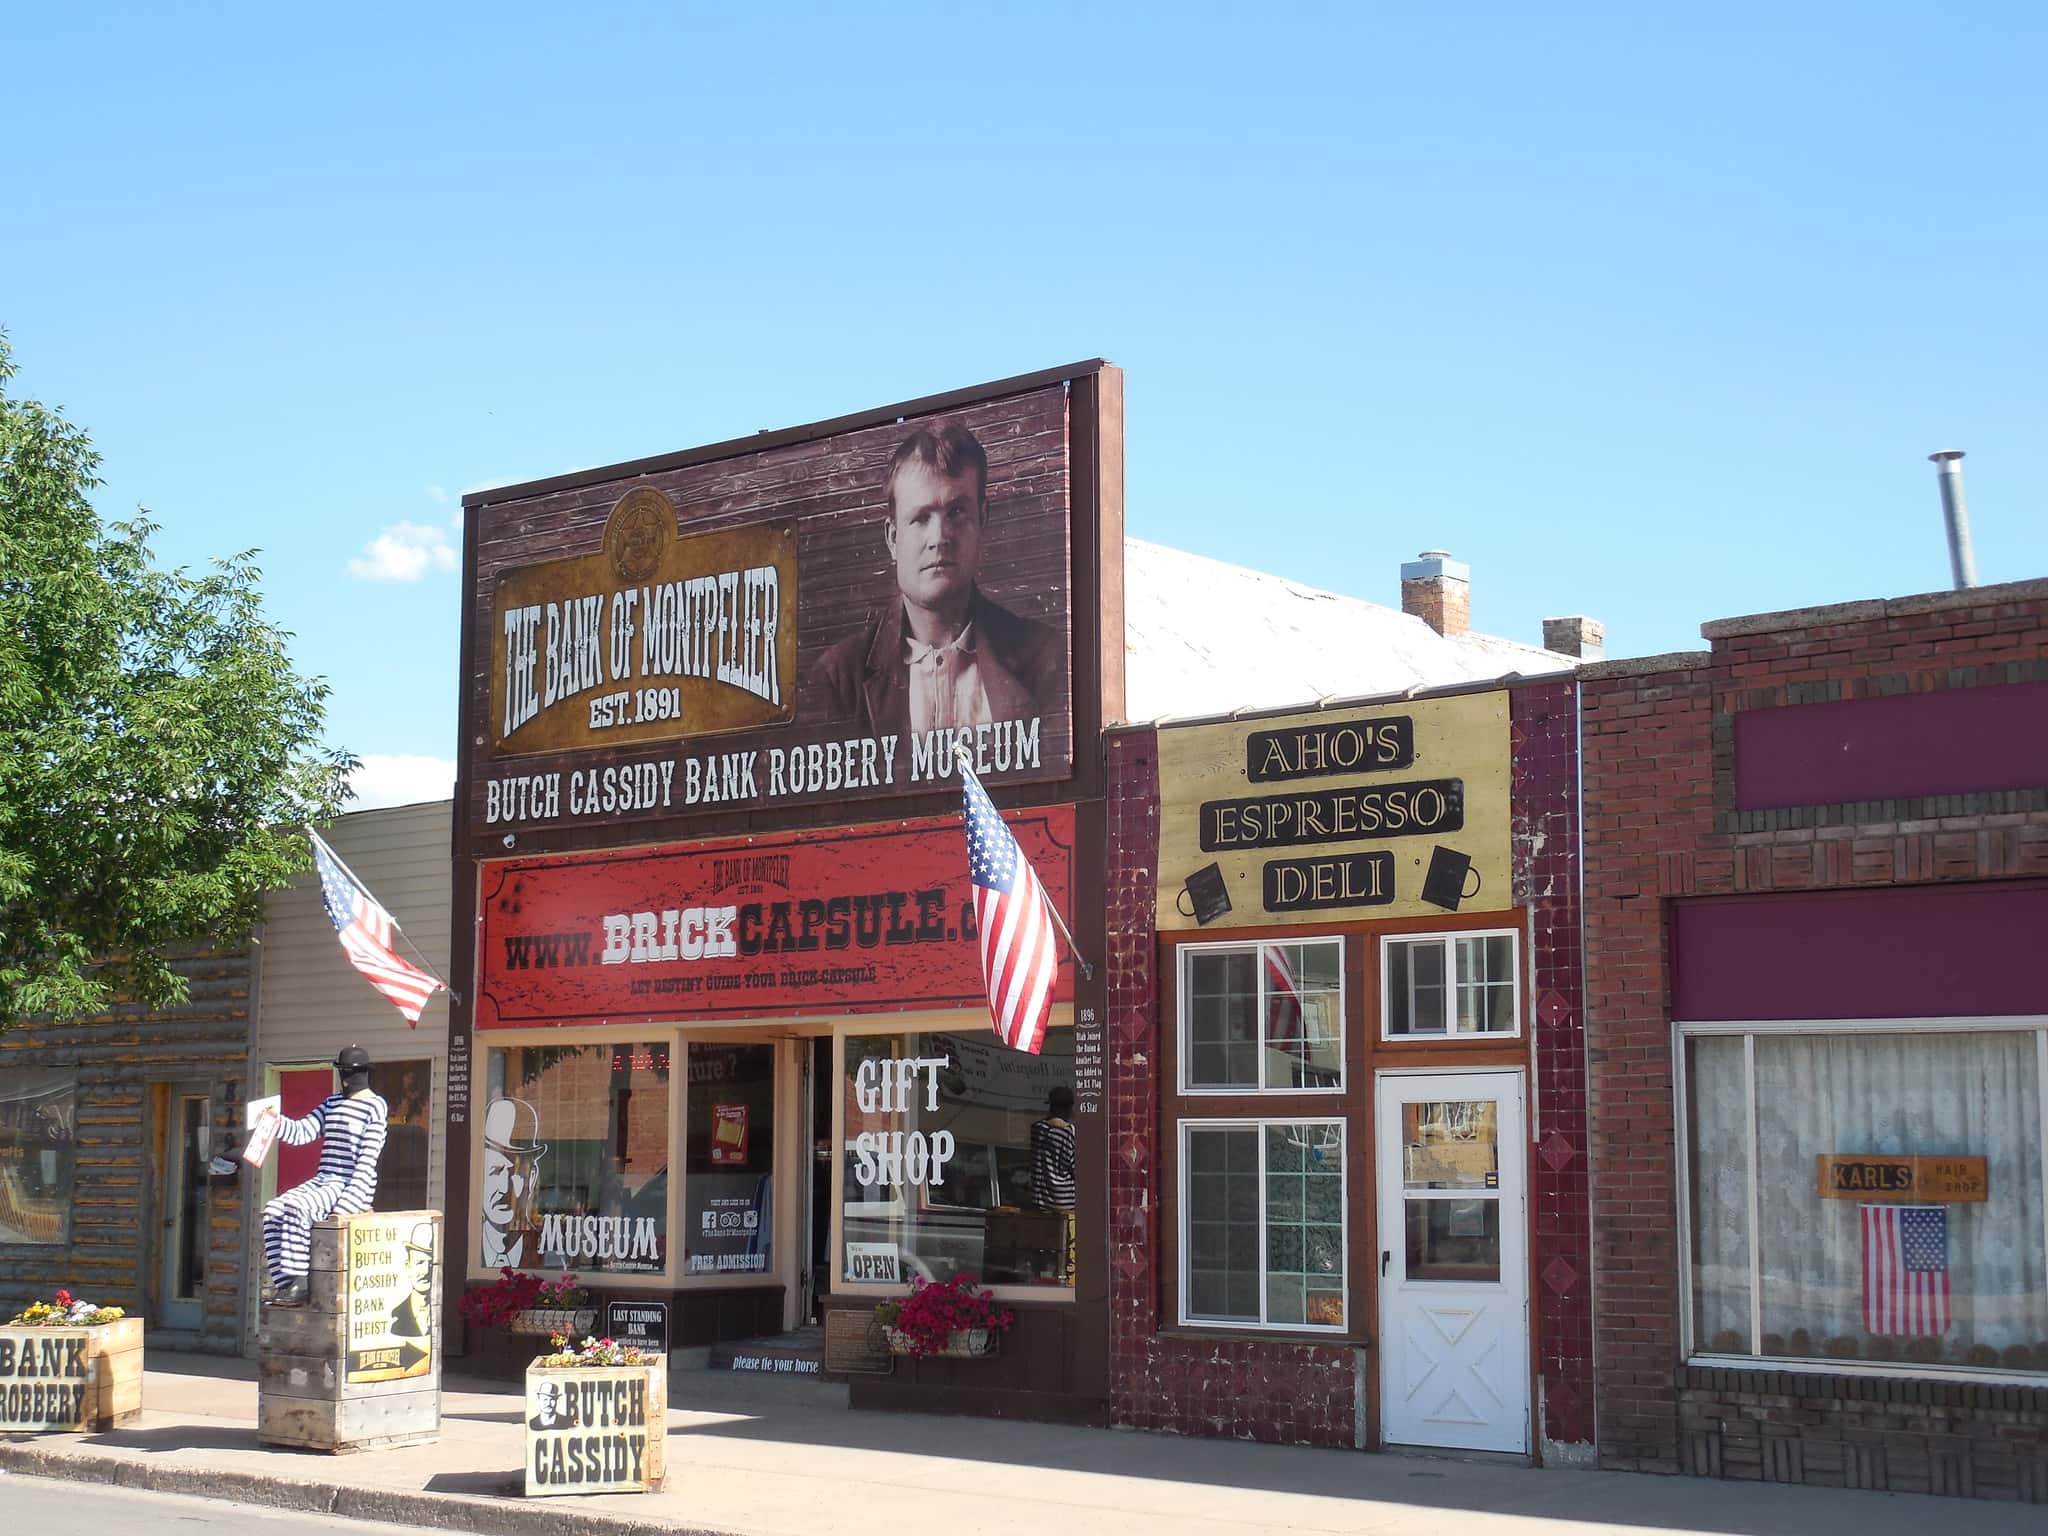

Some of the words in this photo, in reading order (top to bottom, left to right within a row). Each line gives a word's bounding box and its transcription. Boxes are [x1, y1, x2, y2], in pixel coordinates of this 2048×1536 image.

[503, 605, 542, 738] THE
[544, 594, 604, 709] BANK
[610, 589, 638, 680] OF
[640, 565, 780, 706] MONTPELIER
[589, 691, 632, 729] EST.
[635, 687, 681, 723] 1891
[1259, 725, 1400, 775] AHO'S
[486, 772, 560, 824] BUTCH
[570, 760, 675, 815] CASSIDY
[685, 751, 758, 805] BANK
[769, 734, 899, 796] ROBBERY
[911, 717, 1041, 781] MUSEUM
[1214, 788, 1445, 844] ESPRESSO
[1275, 859, 1384, 903] DELI
[706, 975, 741, 991] GUIDE
[744, 973, 776, 988] YOUR
[1081, 1008, 1095, 1022] 1896
[854, 1053, 950, 1113] GIFT
[854, 1129, 955, 1186] SHOP
[354, 1228, 380, 1246] SITE
[386, 1228, 398, 1241] OF
[537, 1214, 659, 1260] MUSEUM
[355, 1251, 392, 1269] BUTCH
[691, 1254, 714, 1271] FREE
[717, 1254, 765, 1270] ADMISSION
[853, 1255, 895, 1280] OPEN
[354, 1274, 399, 1292] CASSIDY
[355, 1298, 385, 1315] BANK
[613, 1309, 628, 1321] LAST
[630, 1310, 662, 1322] STANDING
[354, 1321, 388, 1339] HEIST
[628, 1323, 646, 1335] BANK
[0, 1338, 87, 1376] BANK
[733, 1355, 759, 1370] please
[761, 1357, 772, 1370] tie
[773, 1359, 794, 1372] your
[795, 1358, 819, 1373] horse
[0, 1384, 85, 1423] ROBBERY
[564, 1379, 645, 1427] BUTCH
[535, 1435, 645, 1484] CASSIDY
